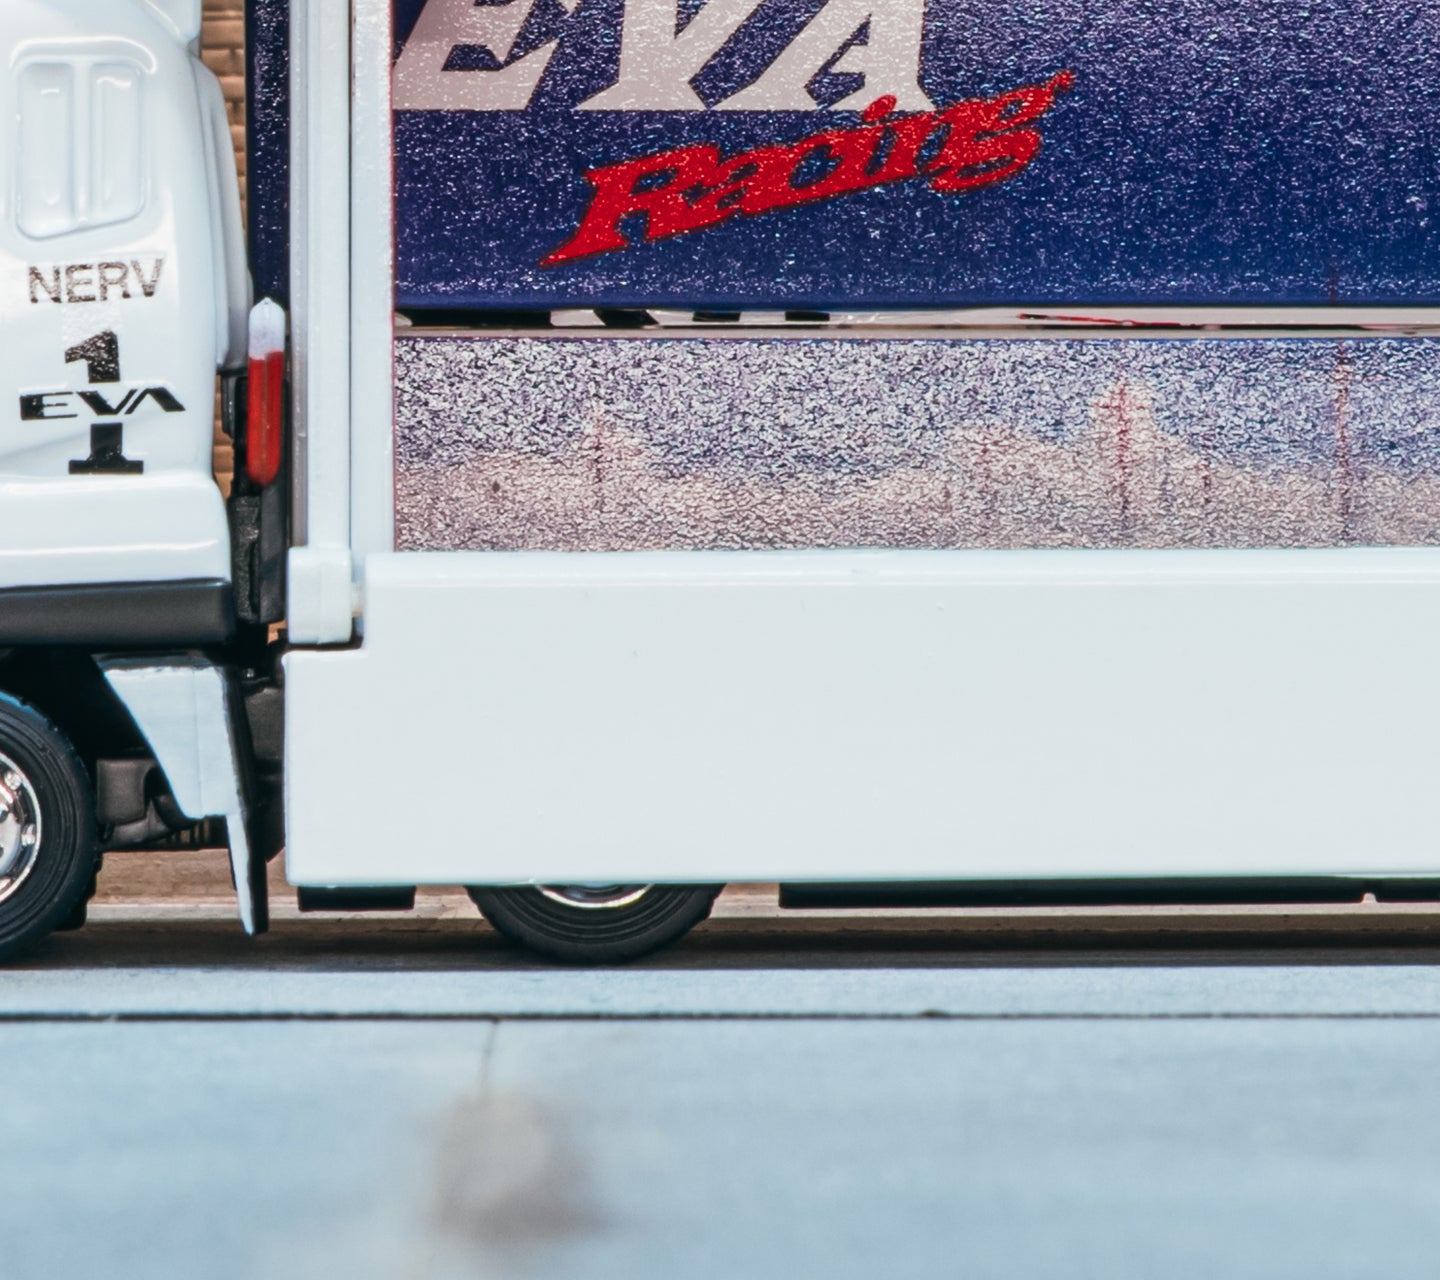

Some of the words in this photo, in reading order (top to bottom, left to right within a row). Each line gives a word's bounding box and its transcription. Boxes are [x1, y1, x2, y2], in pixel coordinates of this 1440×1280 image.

[539, 68, 1077, 269] Racing
[27, 257, 165, 304] NERV
[19, 386, 187, 422] EVA
